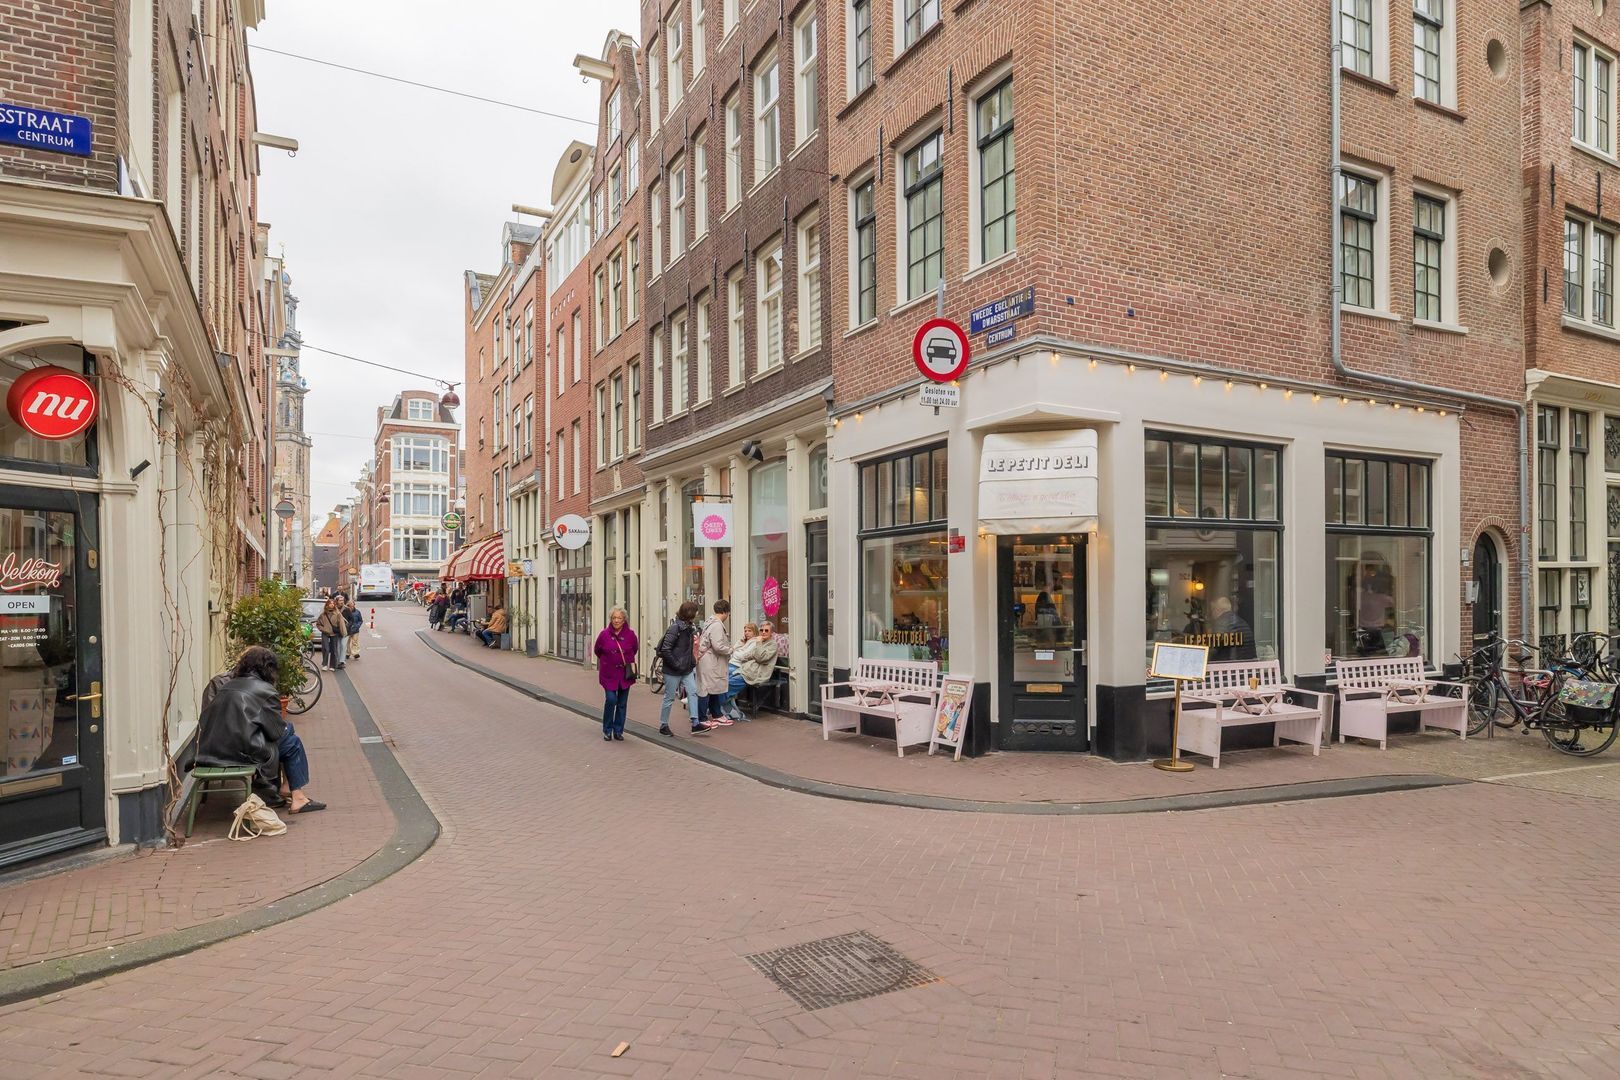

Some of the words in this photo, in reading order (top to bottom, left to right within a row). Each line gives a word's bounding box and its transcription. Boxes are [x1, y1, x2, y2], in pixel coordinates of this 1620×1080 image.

[17, 130, 74, 148] CENTRUM
[972, 306, 993, 322] TWEEDE
[994, 290, 1032, 313] EGELNTIES
[988, 327, 1013, 344] CENTRUM
[924, 386, 946, 396] Gesloten
[27, 391, 89, 420] nu
[987, 457, 1005, 472] LE
[1007, 455, 1050, 472] PETIT
[1052, 454, 1089, 469] DELI
[828, 589, 834, 600] 18
[7, 601, 35, 609] OPEN
[1197, 632, 1221, 647] PETIT
[1223, 632, 1243, 646] DELI
